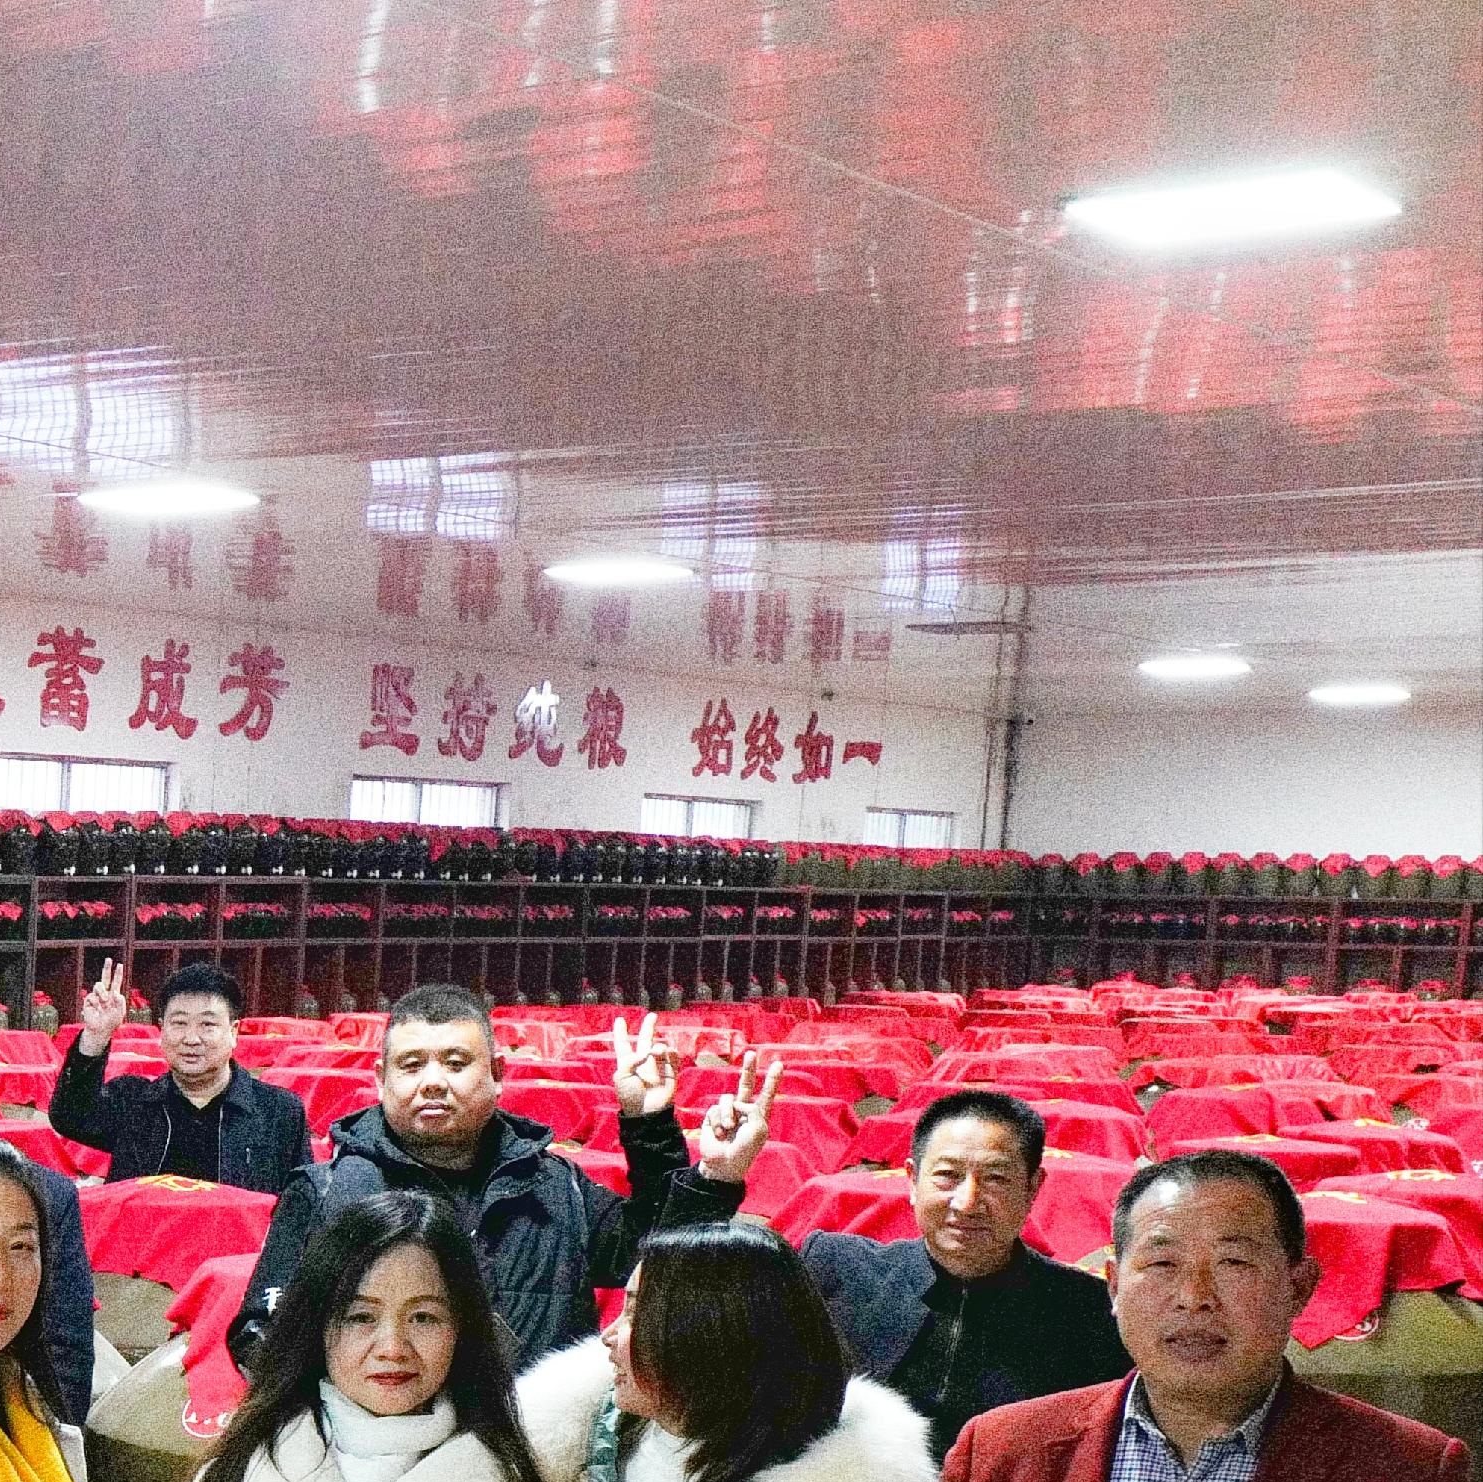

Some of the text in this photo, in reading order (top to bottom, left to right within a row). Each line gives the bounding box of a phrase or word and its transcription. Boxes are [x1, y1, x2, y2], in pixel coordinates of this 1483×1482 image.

[359, 663, 627, 769] 坚持纯粮
[692, 699, 883, 783] 始终如一
